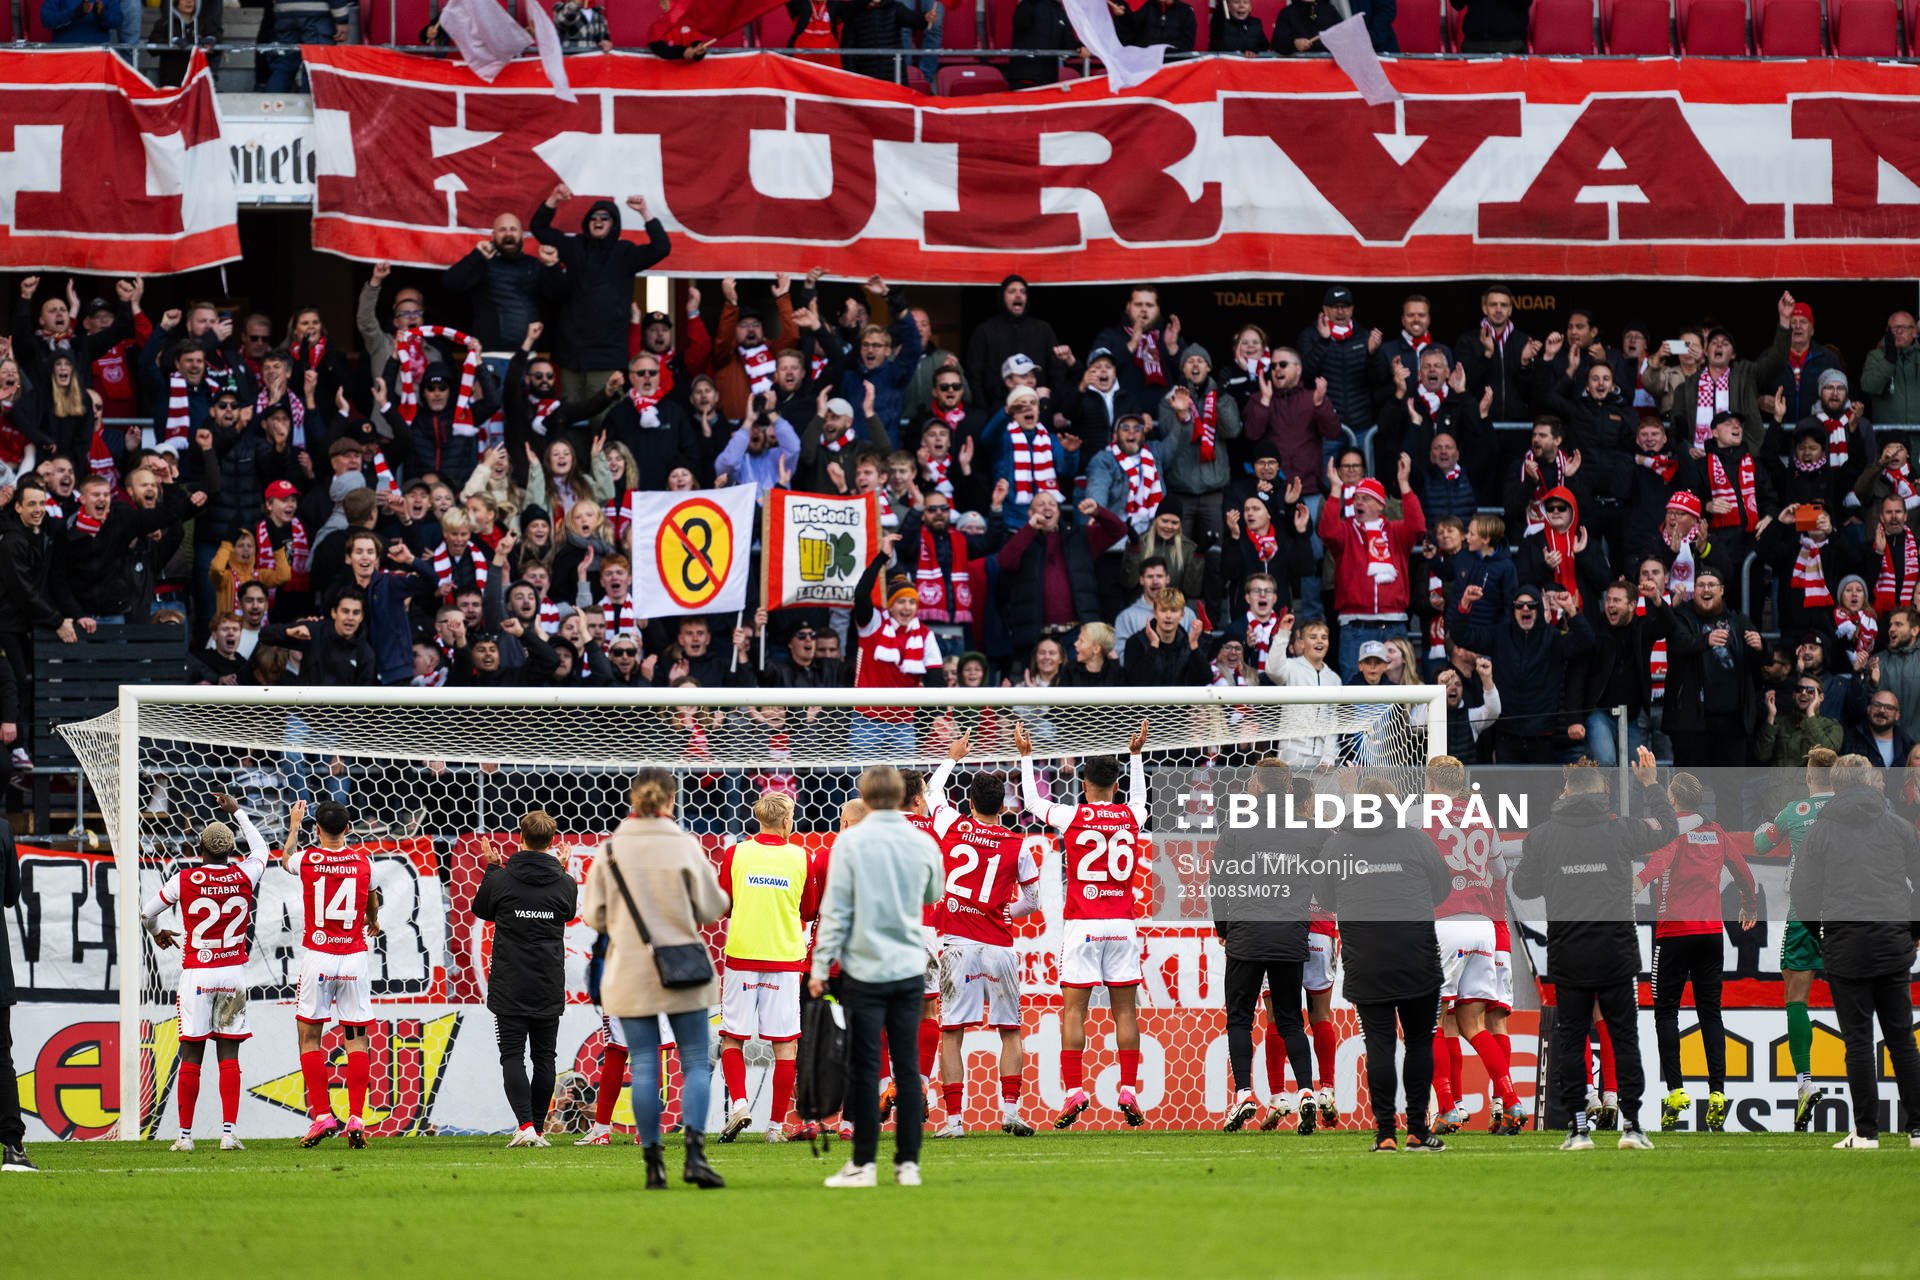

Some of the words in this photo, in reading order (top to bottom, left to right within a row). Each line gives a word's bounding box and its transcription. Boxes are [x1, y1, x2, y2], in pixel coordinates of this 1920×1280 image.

[1214, 291, 1285, 306] TOALETT
[792, 504, 860, 526] McCool's
[961, 832, 1001, 849] HÜMMET
[1076, 830, 1136, 882] 26
[1438, 825, 1490, 880] 39
[313, 864, 358, 875] SHAMOUN
[946, 843, 1002, 904] 21
[1560, 862, 1608, 876] YASKAWA
[748, 875, 789, 888] YASKAWA
[200, 884, 240, 896] NETABAY
[1099, 888, 1125, 900] premier
[313, 876, 358, 930] 14
[514, 909, 555, 920] YASKAWA
[188, 896, 249, 950] 22
